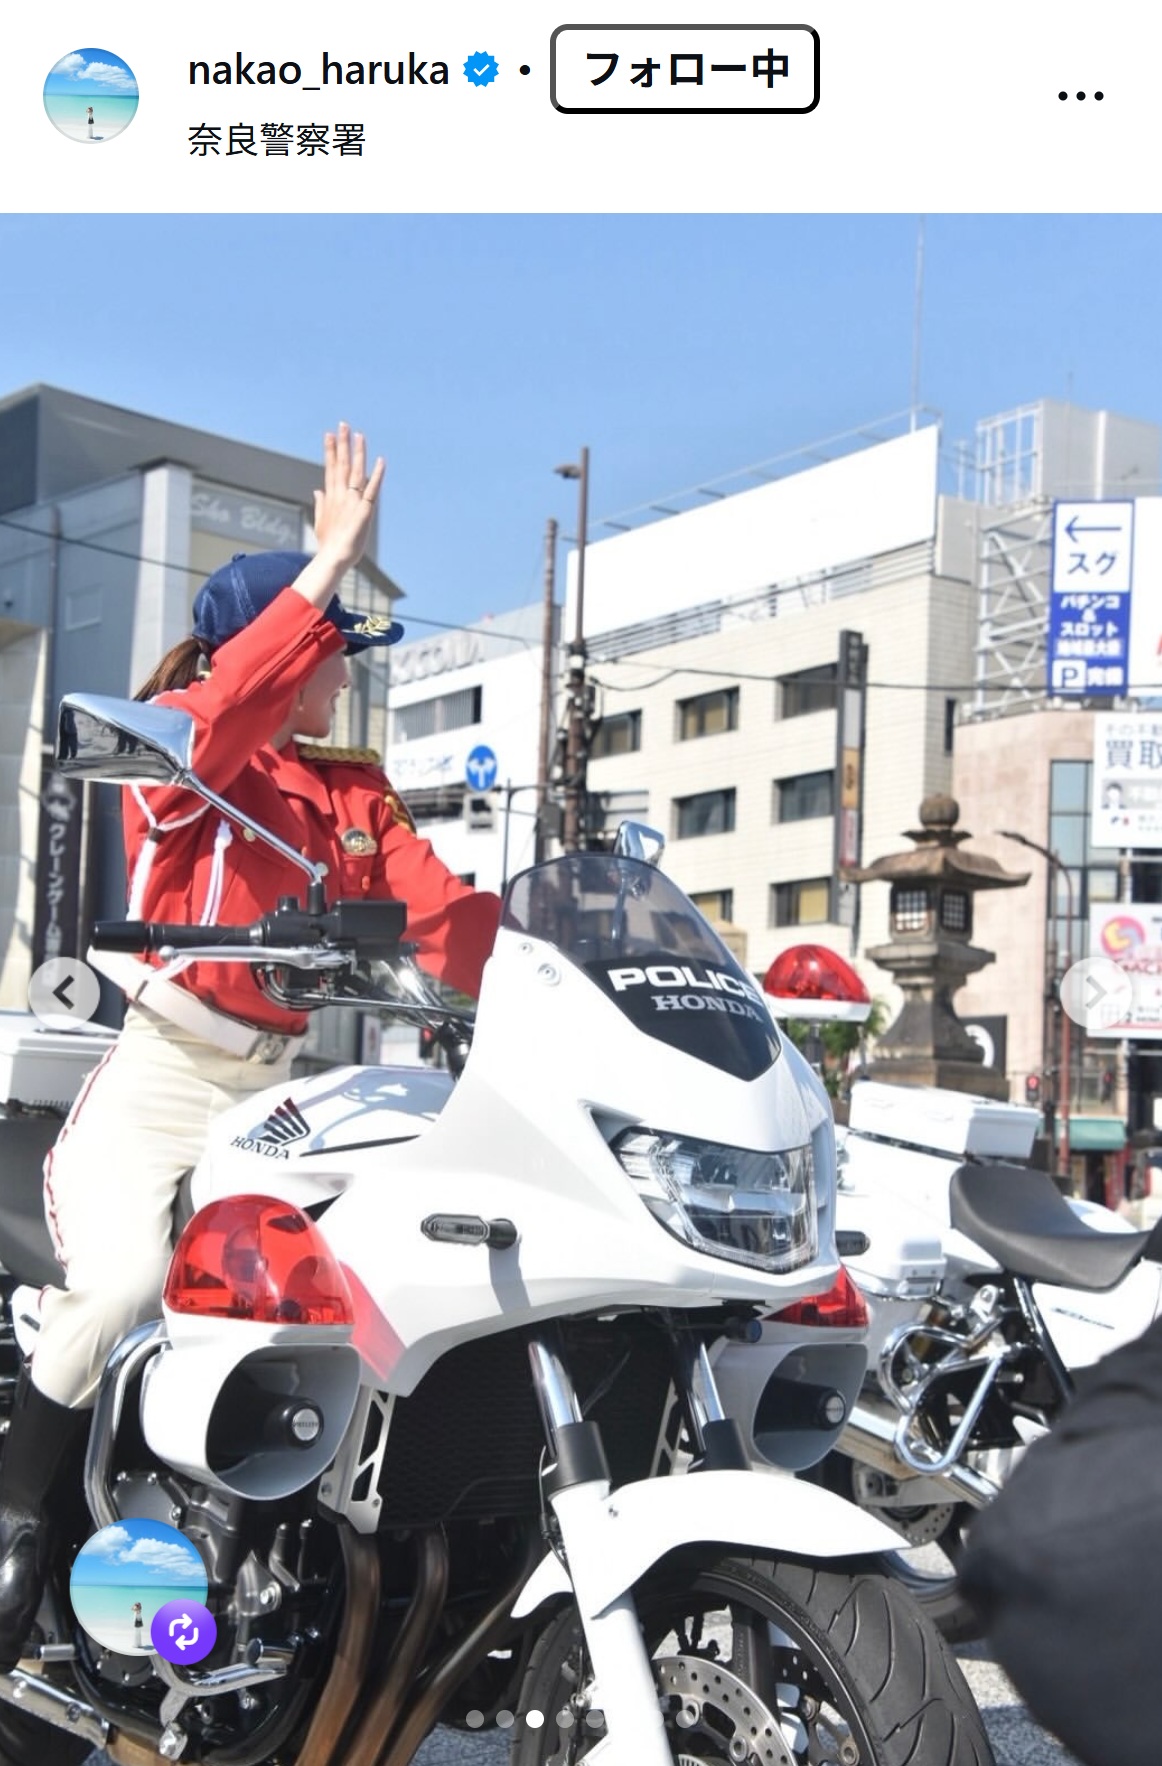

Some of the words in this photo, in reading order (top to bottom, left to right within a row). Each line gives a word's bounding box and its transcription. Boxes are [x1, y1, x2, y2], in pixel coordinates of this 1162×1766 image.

[1060, 621, 1119, 637] スロット
[650, 994, 763, 1022] HONDA
[229, 1136, 291, 1160] HONDA
